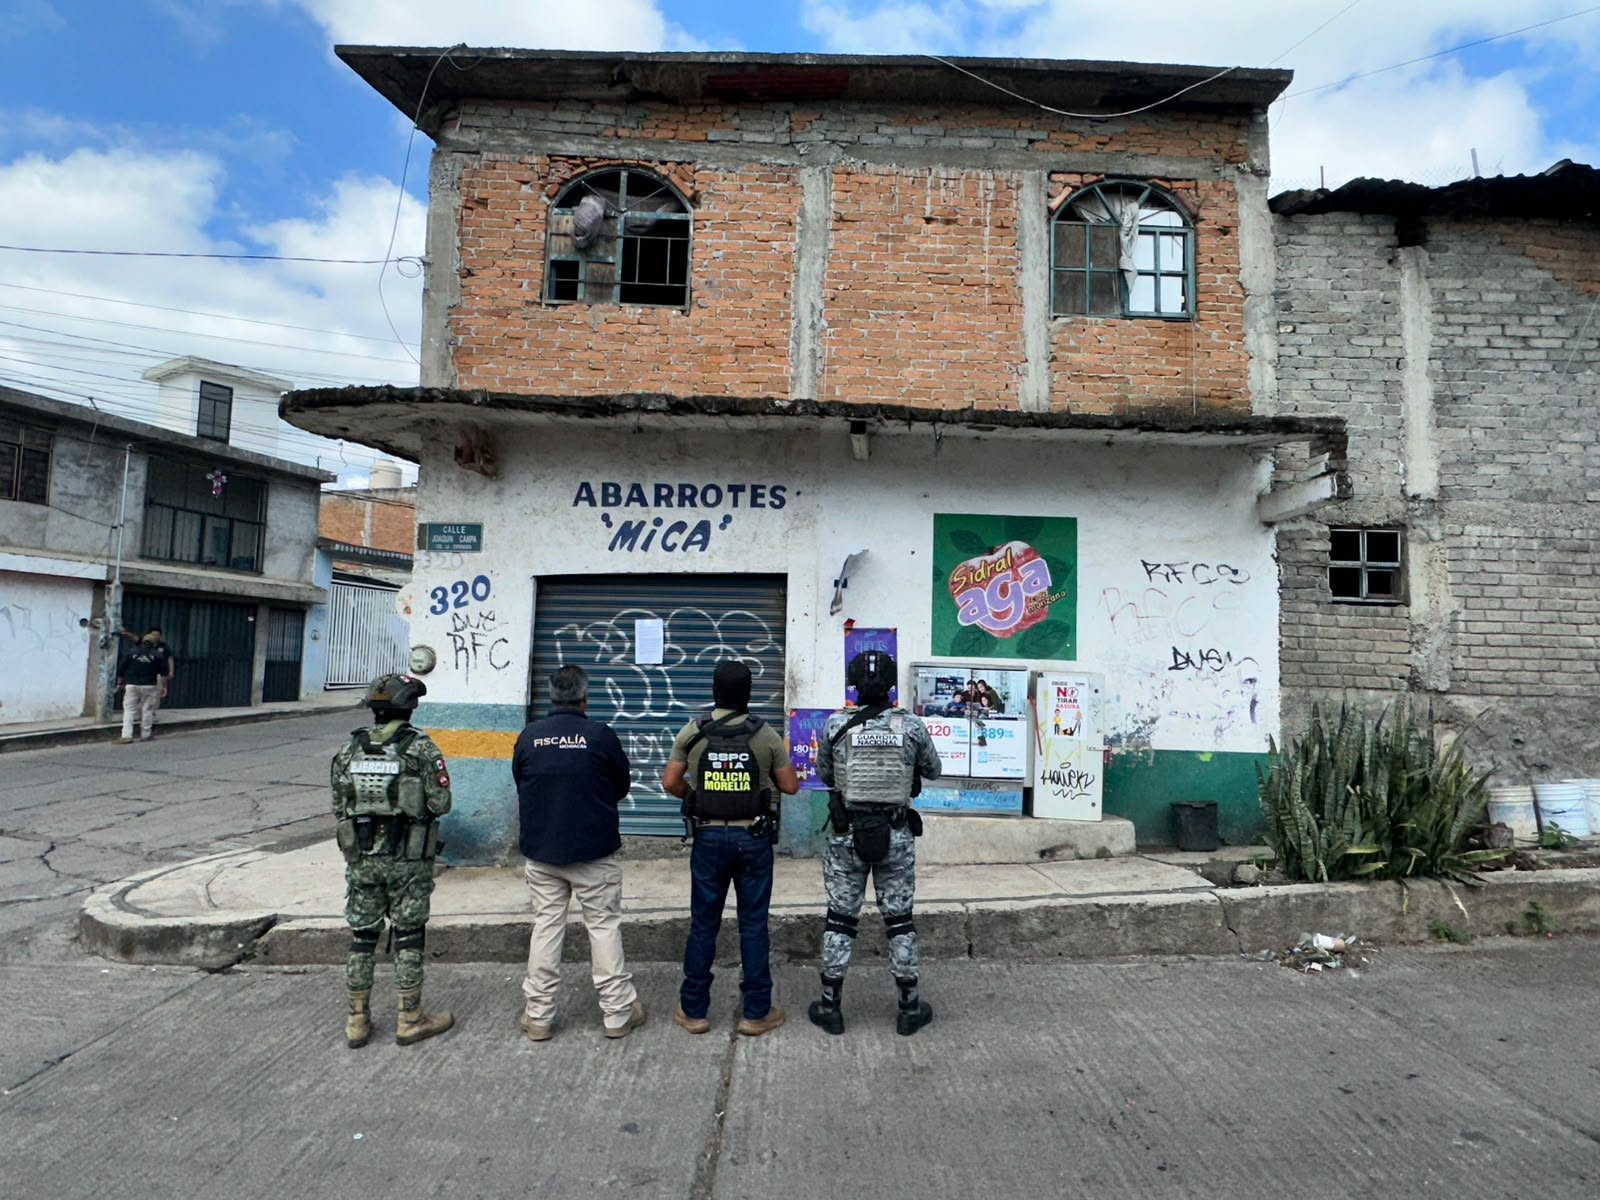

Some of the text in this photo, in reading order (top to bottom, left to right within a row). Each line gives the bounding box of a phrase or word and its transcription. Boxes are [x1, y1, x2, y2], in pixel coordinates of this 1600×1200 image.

[572, 481, 788, 510] ABARROTES
[442, 525, 466, 534] CALLE
[952, 547, 1013, 594] Sidral
[429, 574, 491, 615] 320
[533, 733, 587, 748] FISCALÍA
[708, 752, 750, 761] SSPC
[351, 761, 398, 774] EJERCITO
[704, 771, 751, 781] POLICIA
[704, 780, 751, 791] MORELIA
